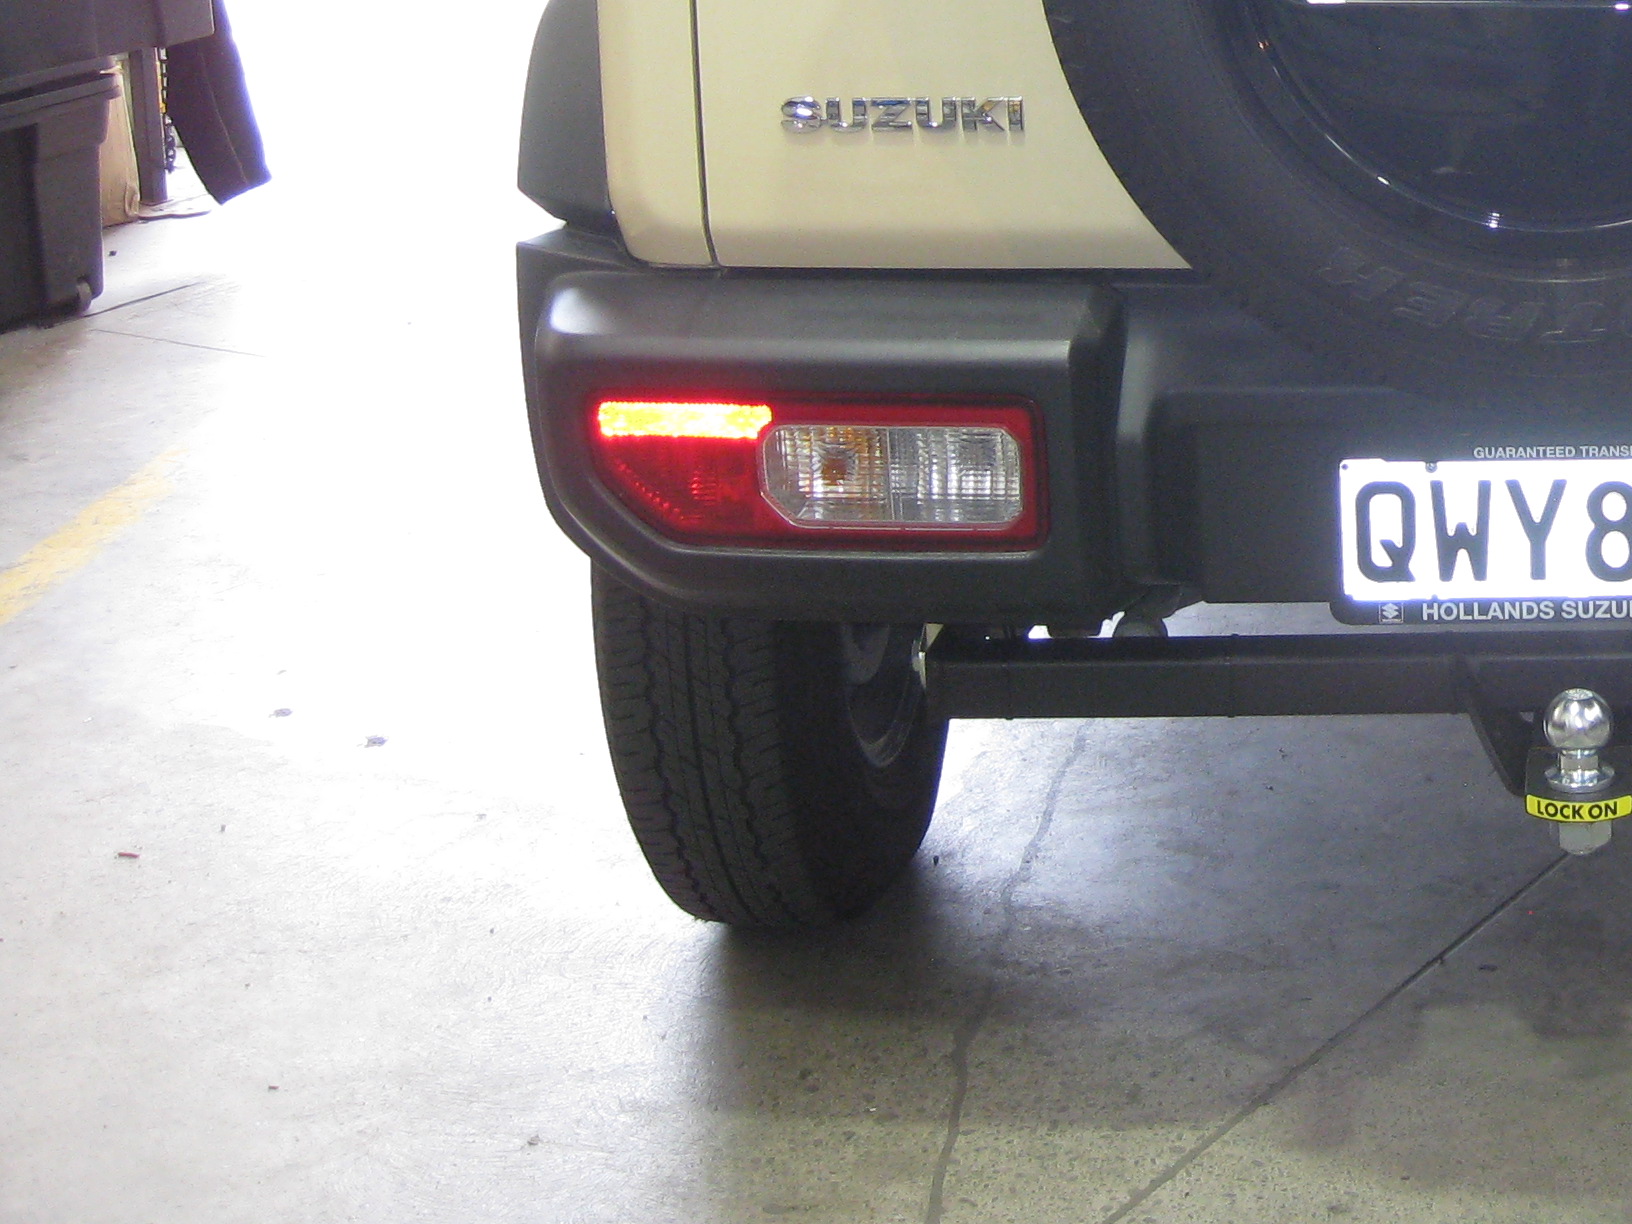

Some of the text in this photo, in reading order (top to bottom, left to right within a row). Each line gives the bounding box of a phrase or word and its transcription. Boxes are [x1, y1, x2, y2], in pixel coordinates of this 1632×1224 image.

[780, 94, 1026, 133] SUZUKI
[1473, 445, 1576, 460] GUARANTEED
[1421, 601, 1555, 622] HOLLANDS
[1536, 800, 1618, 819] LOCK ON
